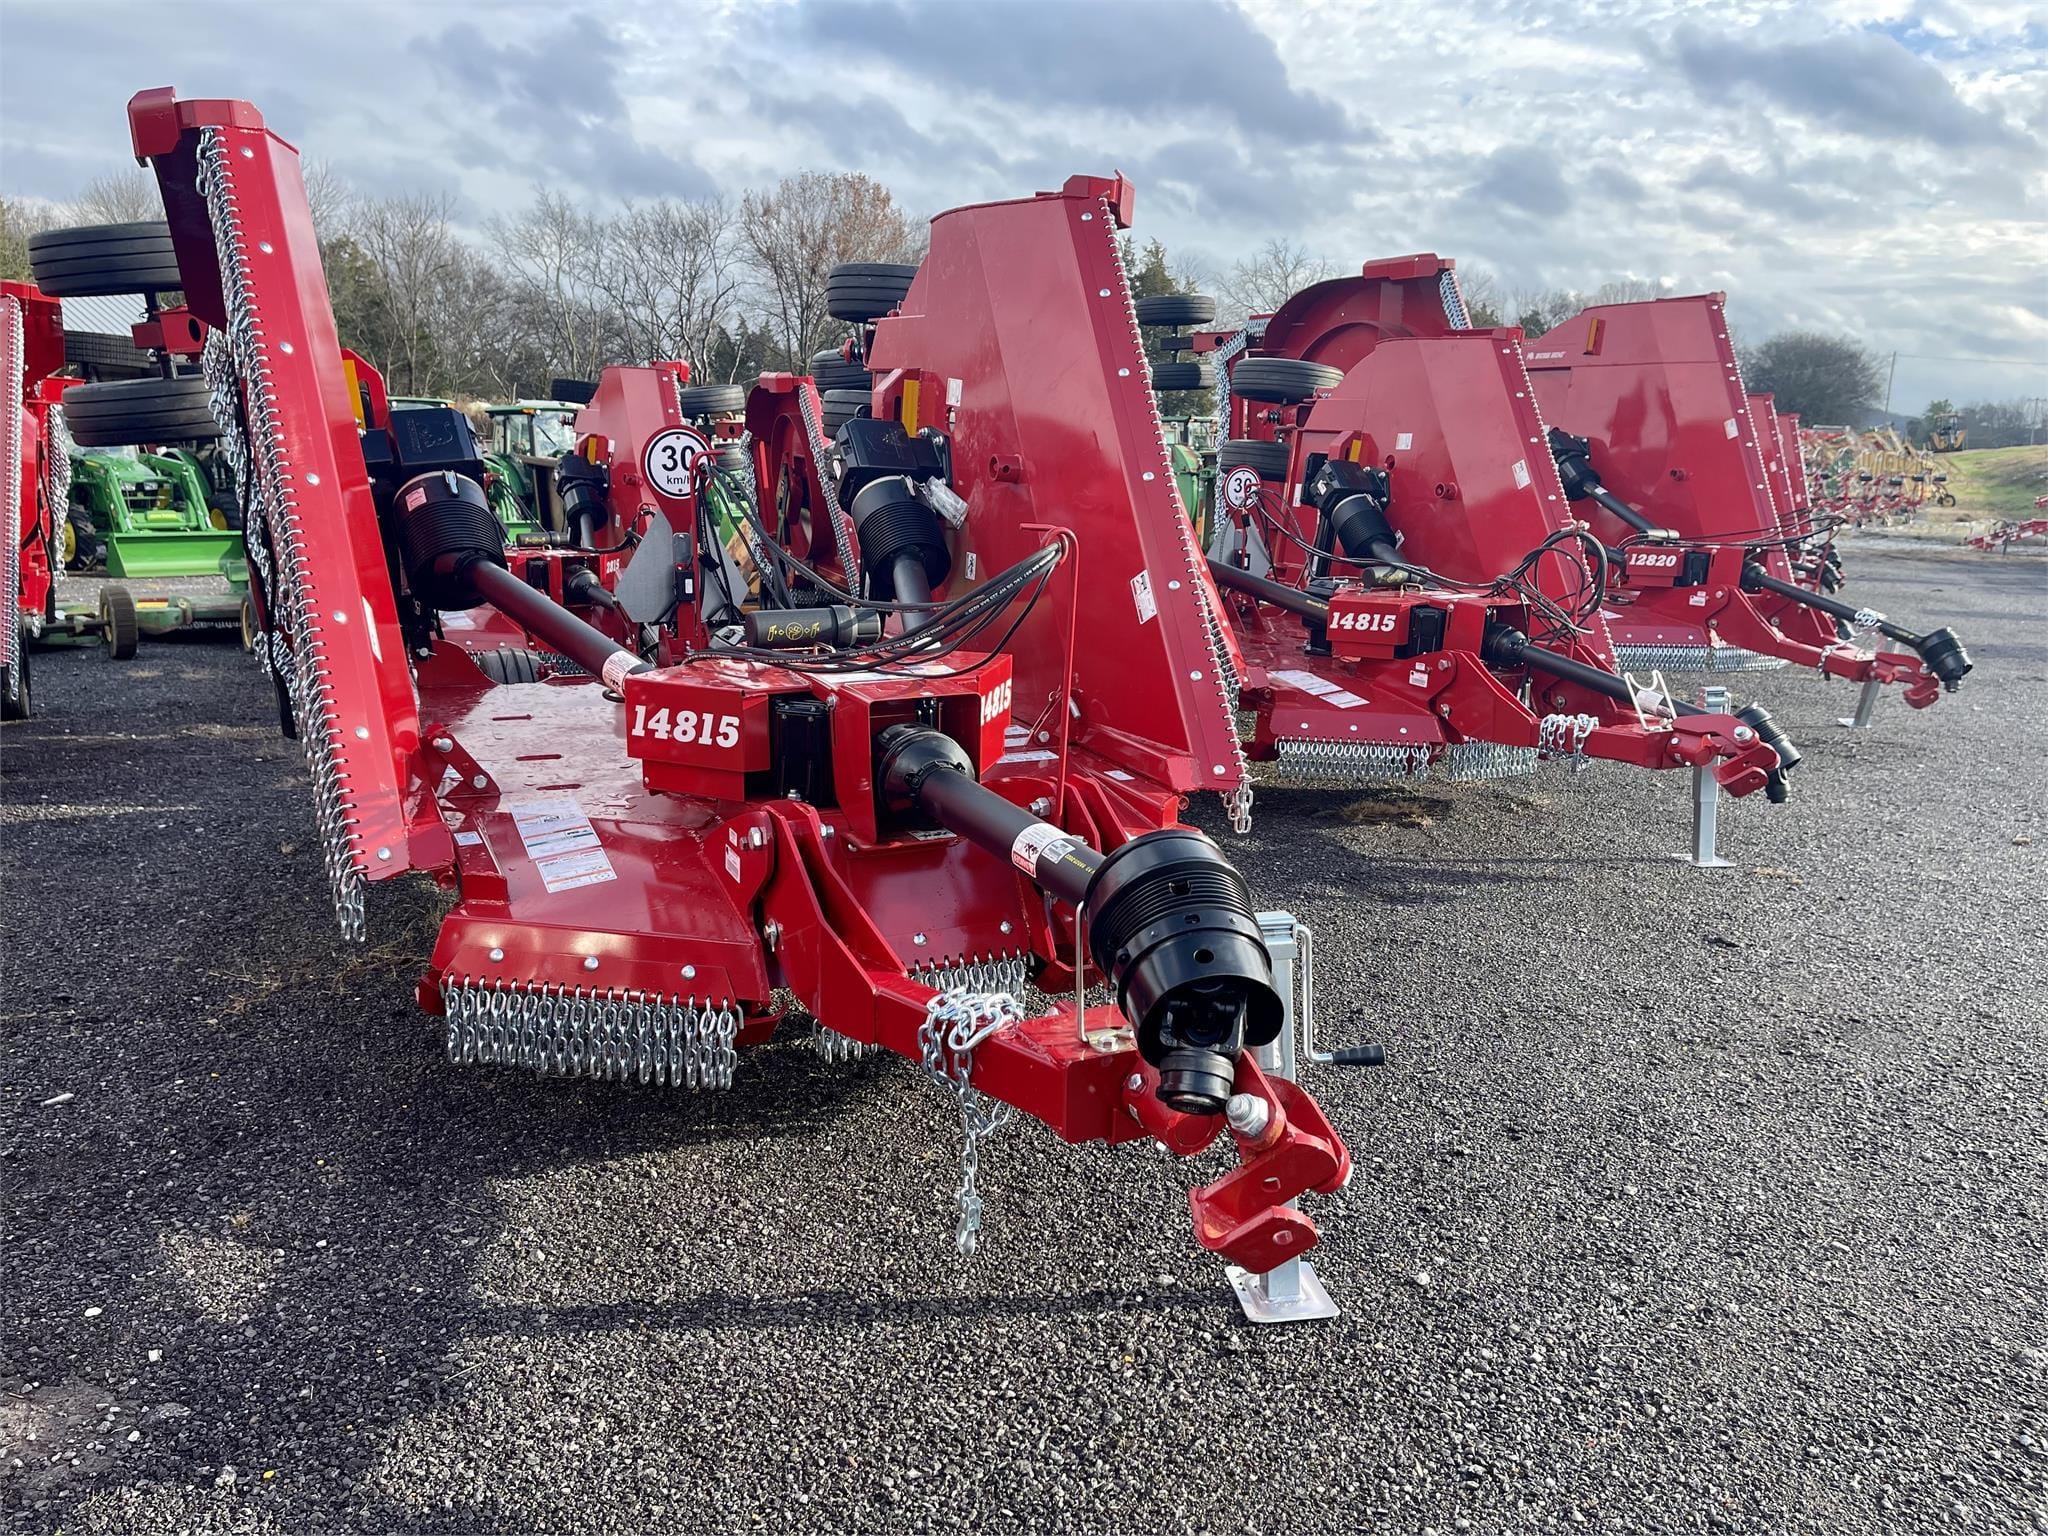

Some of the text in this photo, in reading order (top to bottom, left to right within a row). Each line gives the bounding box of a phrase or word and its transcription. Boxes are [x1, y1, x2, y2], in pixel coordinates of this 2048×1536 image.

[661, 445, 696, 472] 30
[1233, 477, 1252, 493] 30
[1629, 553, 1677, 567] 12820
[1329, 612, 1397, 632] 14815
[981, 678, 1012, 727] 14815
[631, 705, 740, 748] 14815
